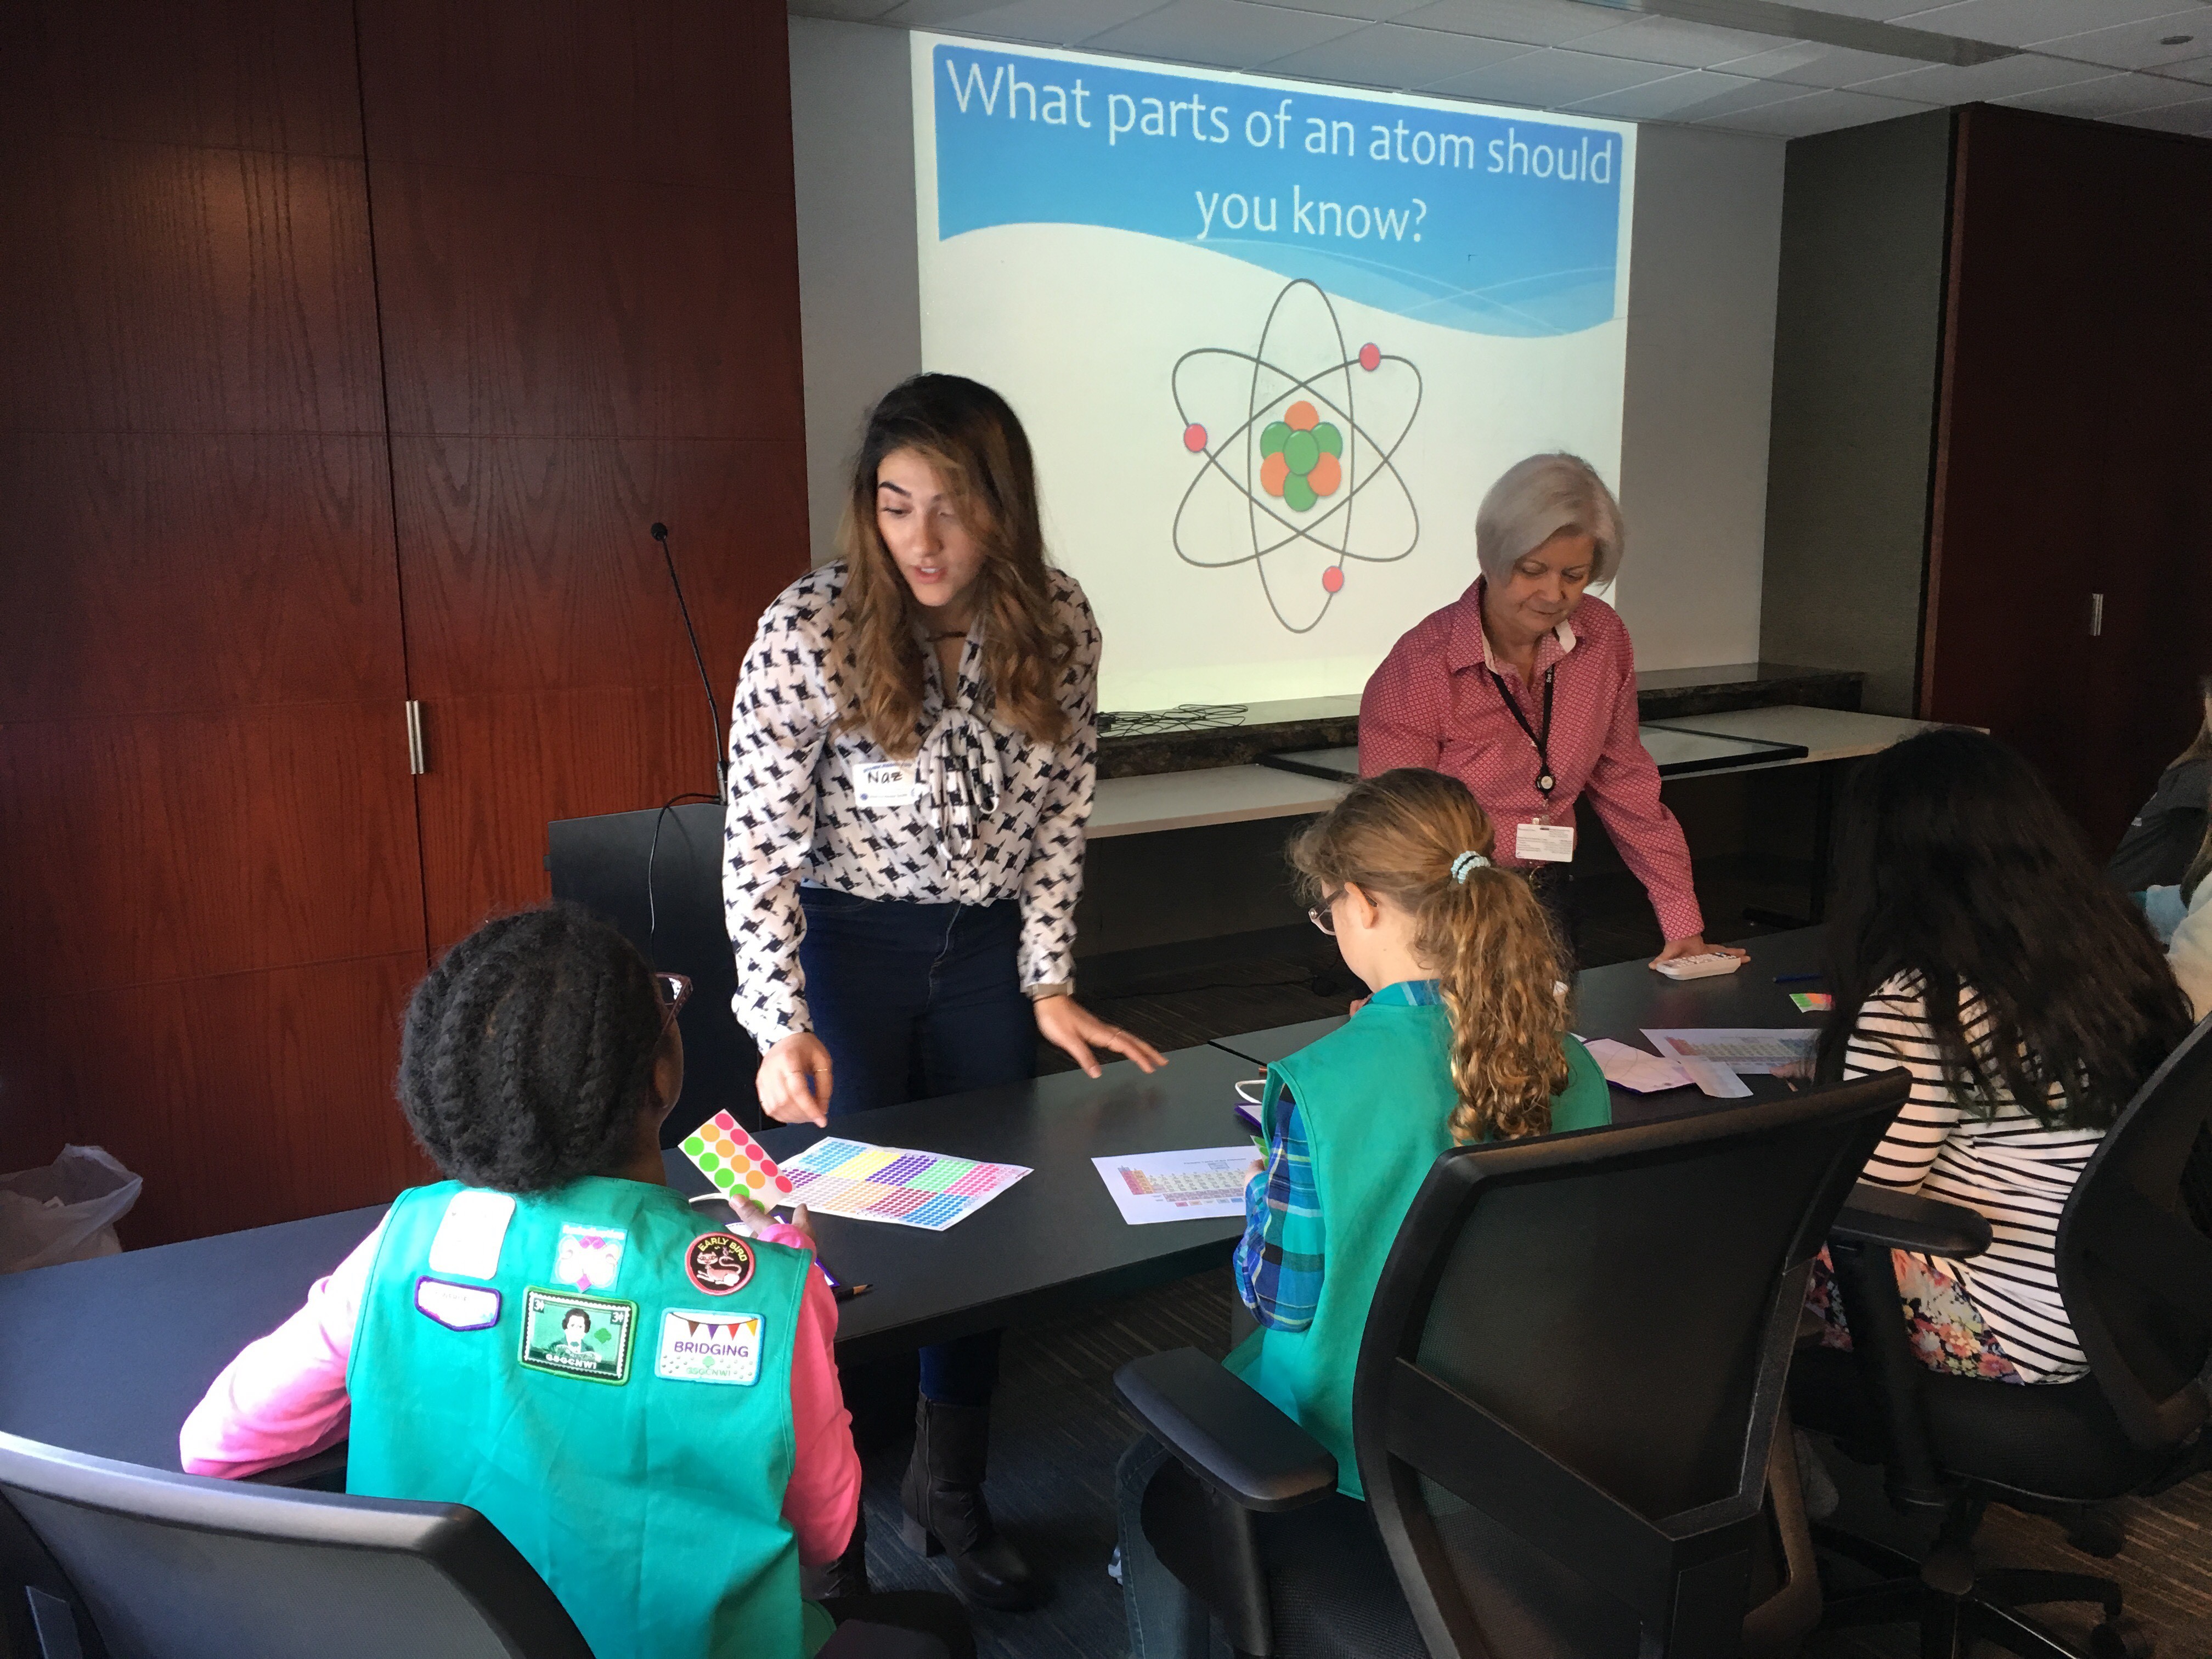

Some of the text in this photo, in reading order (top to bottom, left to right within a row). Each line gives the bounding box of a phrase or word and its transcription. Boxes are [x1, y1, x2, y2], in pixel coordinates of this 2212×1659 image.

[946, 59, 1612, 184] What parts of an atom should
[1195, 184, 1427, 243] you know?
[867, 770, 903, 783] Naz
[698, 1237, 748, 1262] EARLY BIRD
[674, 1341, 749, 1358] BRIDGING
